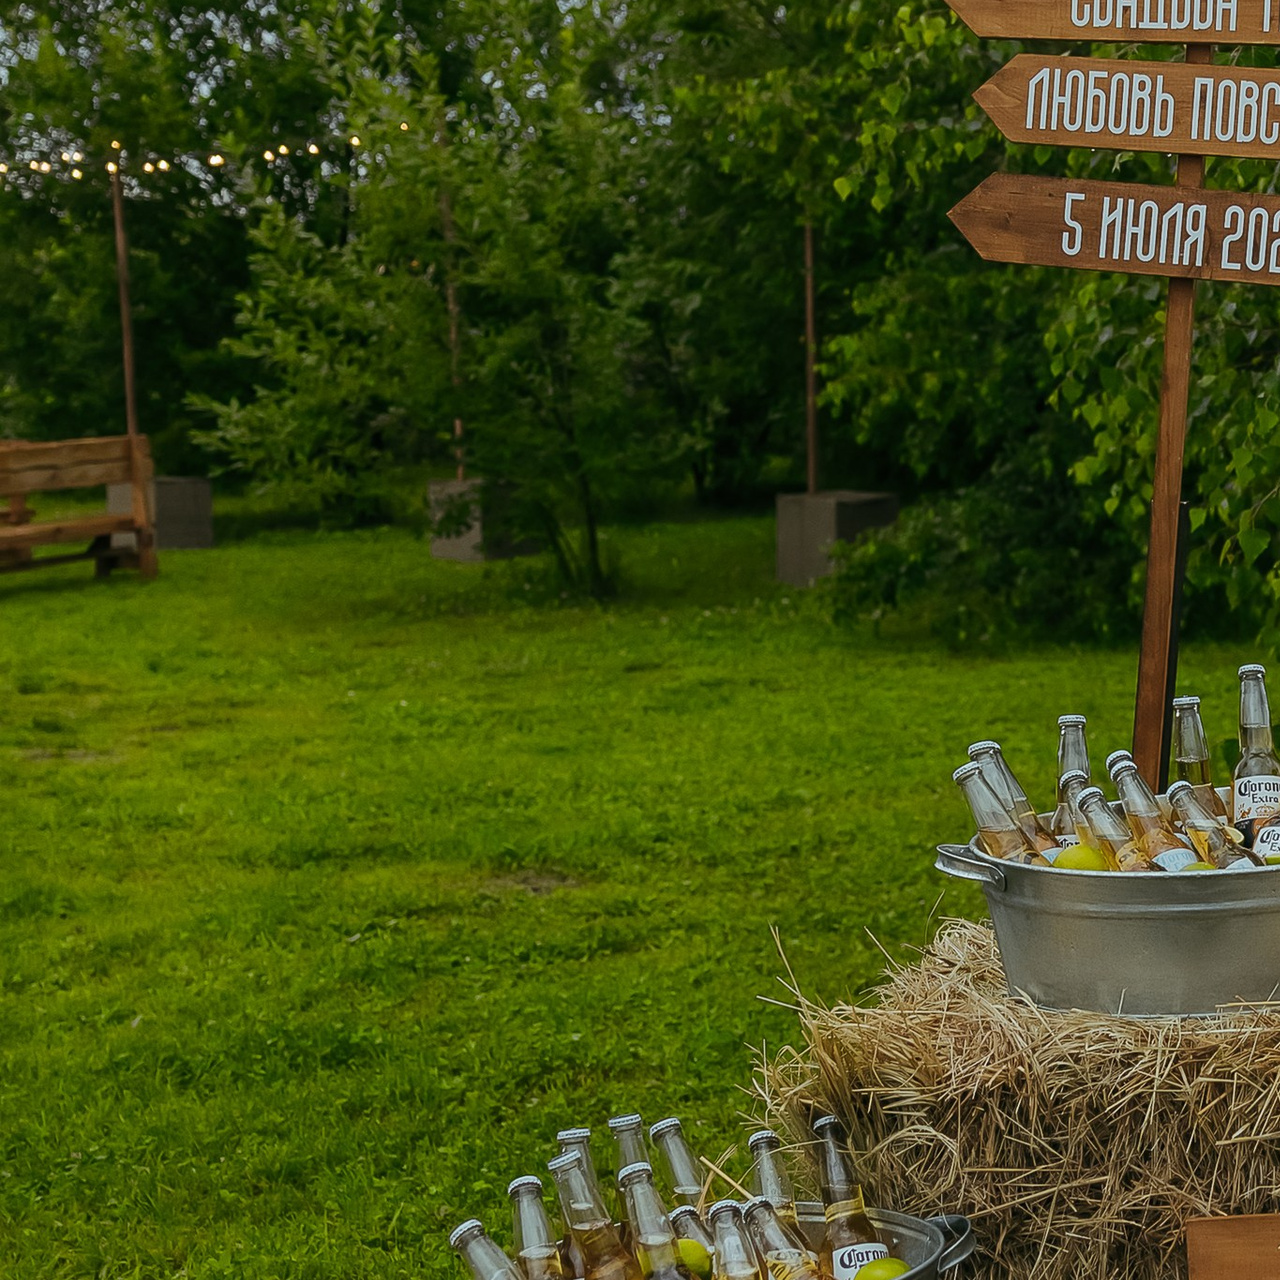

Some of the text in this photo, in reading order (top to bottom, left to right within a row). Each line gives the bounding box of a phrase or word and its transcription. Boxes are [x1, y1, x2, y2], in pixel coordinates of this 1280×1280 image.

[1025, 67, 1175, 137] ЛЮБОВЬ
[1062, 193, 1085, 256] 5
[1098, 197, 1207, 267] ИЮЛЯ
[1252, 793, 1279, 804] Extra
